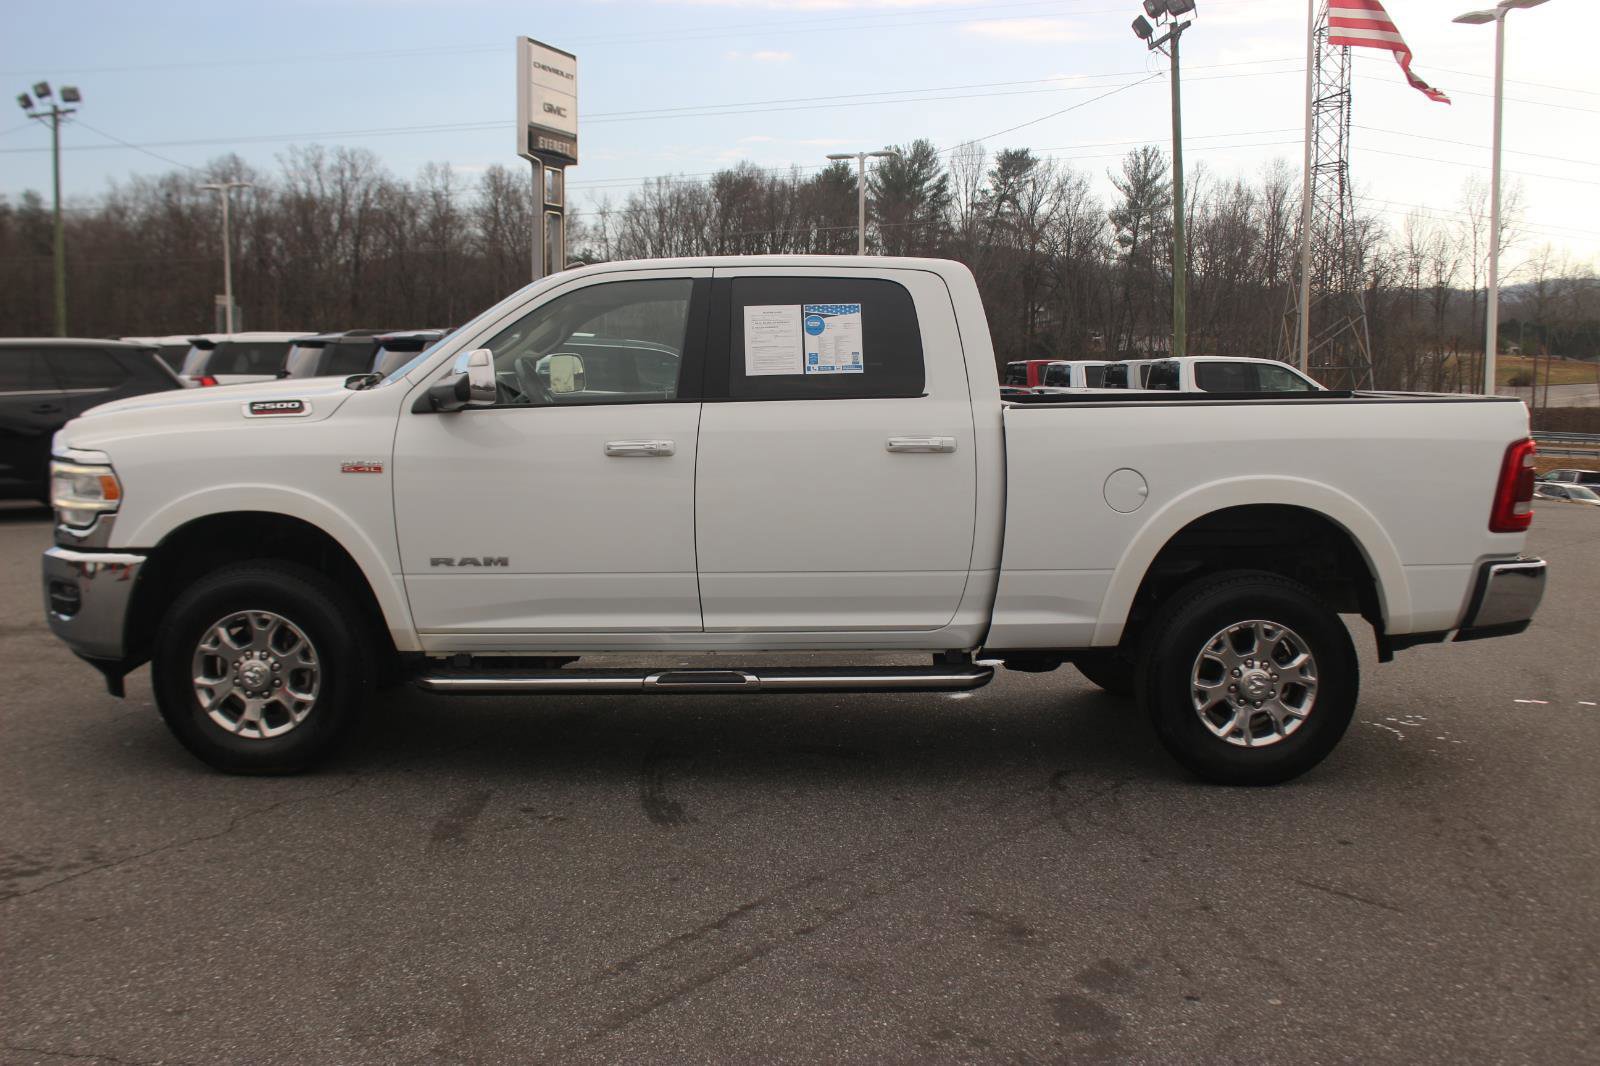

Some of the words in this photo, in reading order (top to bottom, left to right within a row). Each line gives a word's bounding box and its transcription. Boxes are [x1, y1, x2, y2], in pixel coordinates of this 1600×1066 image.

[533, 61, 574, 80] CHEVROLET
[543, 102, 567, 118] GMC
[252, 402, 300, 410] 2500
[430, 557, 509, 567] RAM
